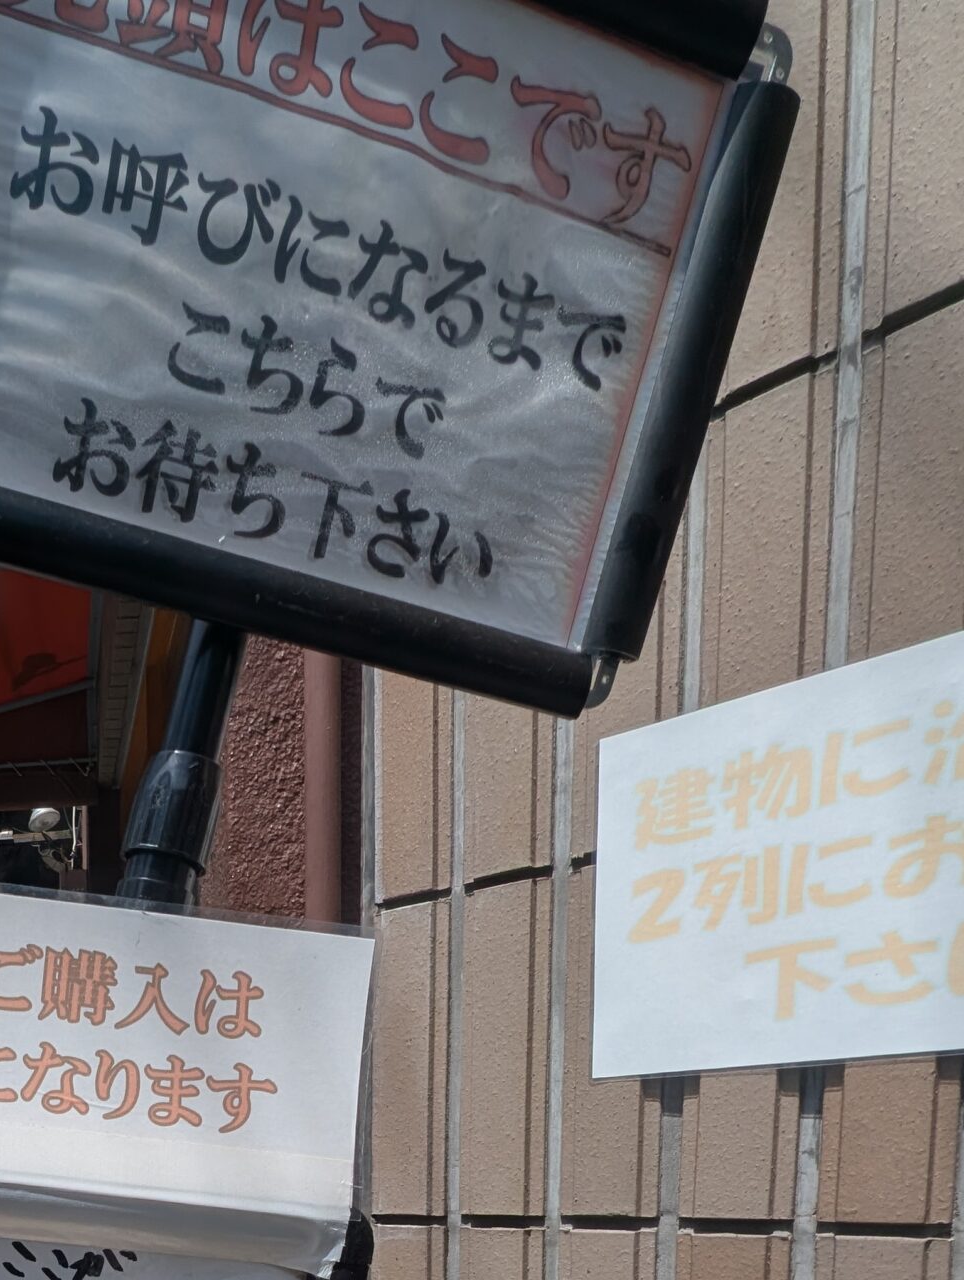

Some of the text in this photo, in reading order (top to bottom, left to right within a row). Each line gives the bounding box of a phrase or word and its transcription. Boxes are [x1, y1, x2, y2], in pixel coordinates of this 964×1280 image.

[9, 104, 628, 392] お呼びになるまで
[167, 300, 446, 460] こちらで
[51, 396, 494, 586] お待ち下さい
